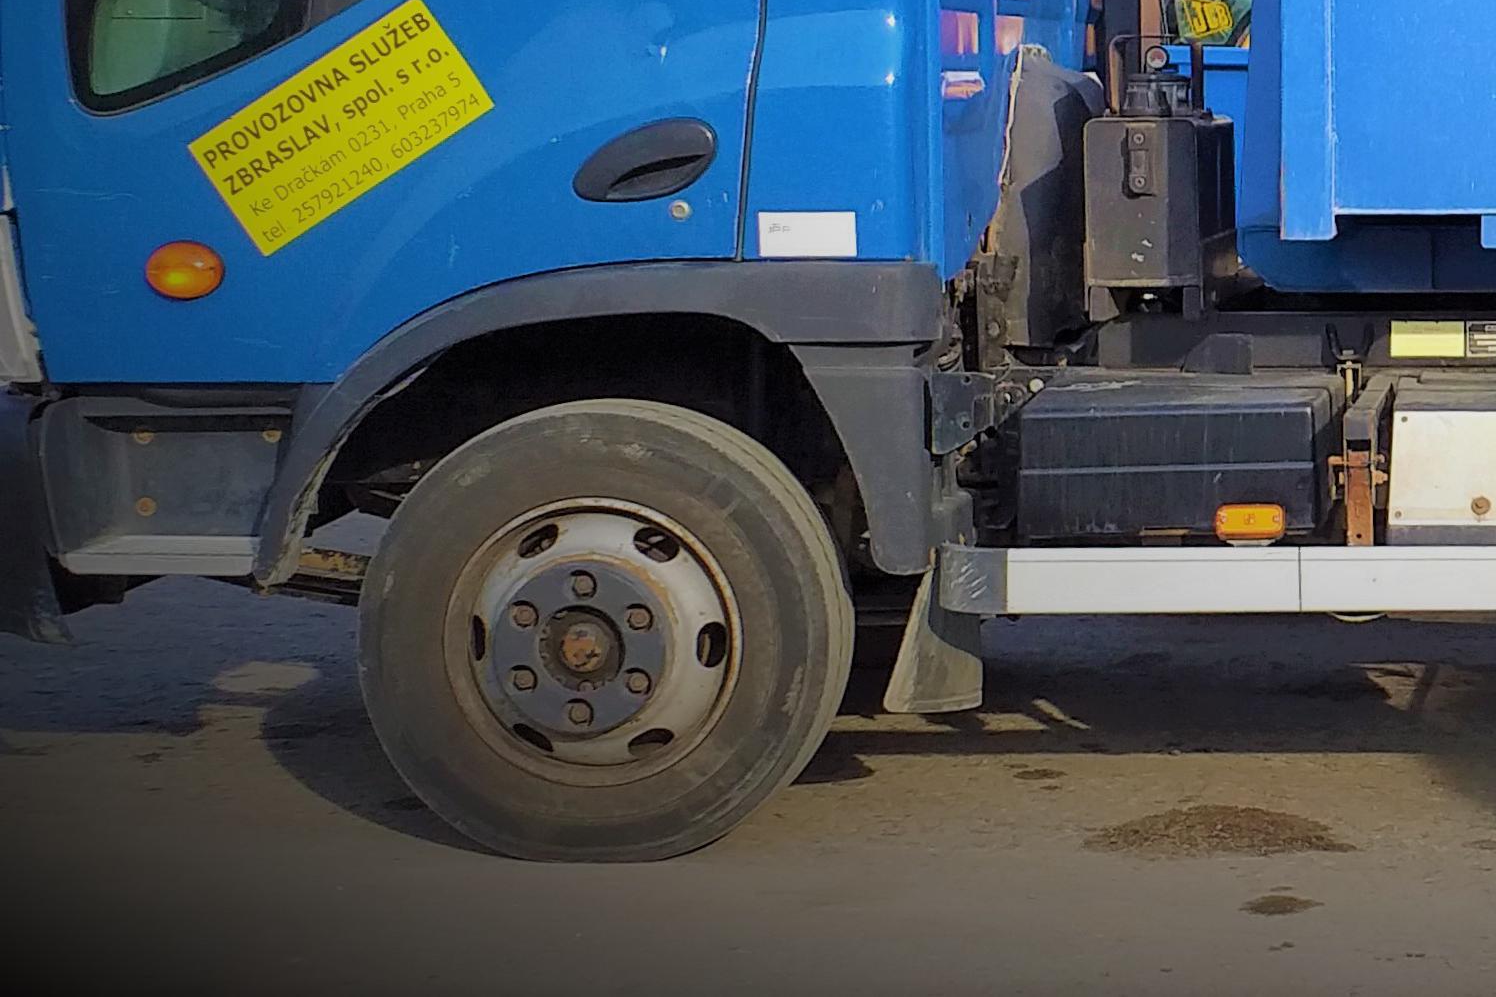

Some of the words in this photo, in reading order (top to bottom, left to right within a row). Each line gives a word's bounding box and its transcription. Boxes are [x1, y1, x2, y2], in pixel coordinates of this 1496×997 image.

[203, 67, 350, 169] PROVOZOVNA
[348, 12, 431, 74] SLUŽEB
[222, 114, 342, 196] ZBRASLAV,
[342, 78, 394, 121] spol.
[249, 200, 274, 217] Ke
[347, 118, 398, 153] 0231,
[397, 83, 448, 121] Praha
[446, 72, 462, 89] 5
[291, 156, 390, 224] 257921240,
[390, 93, 480, 160] 603237974
